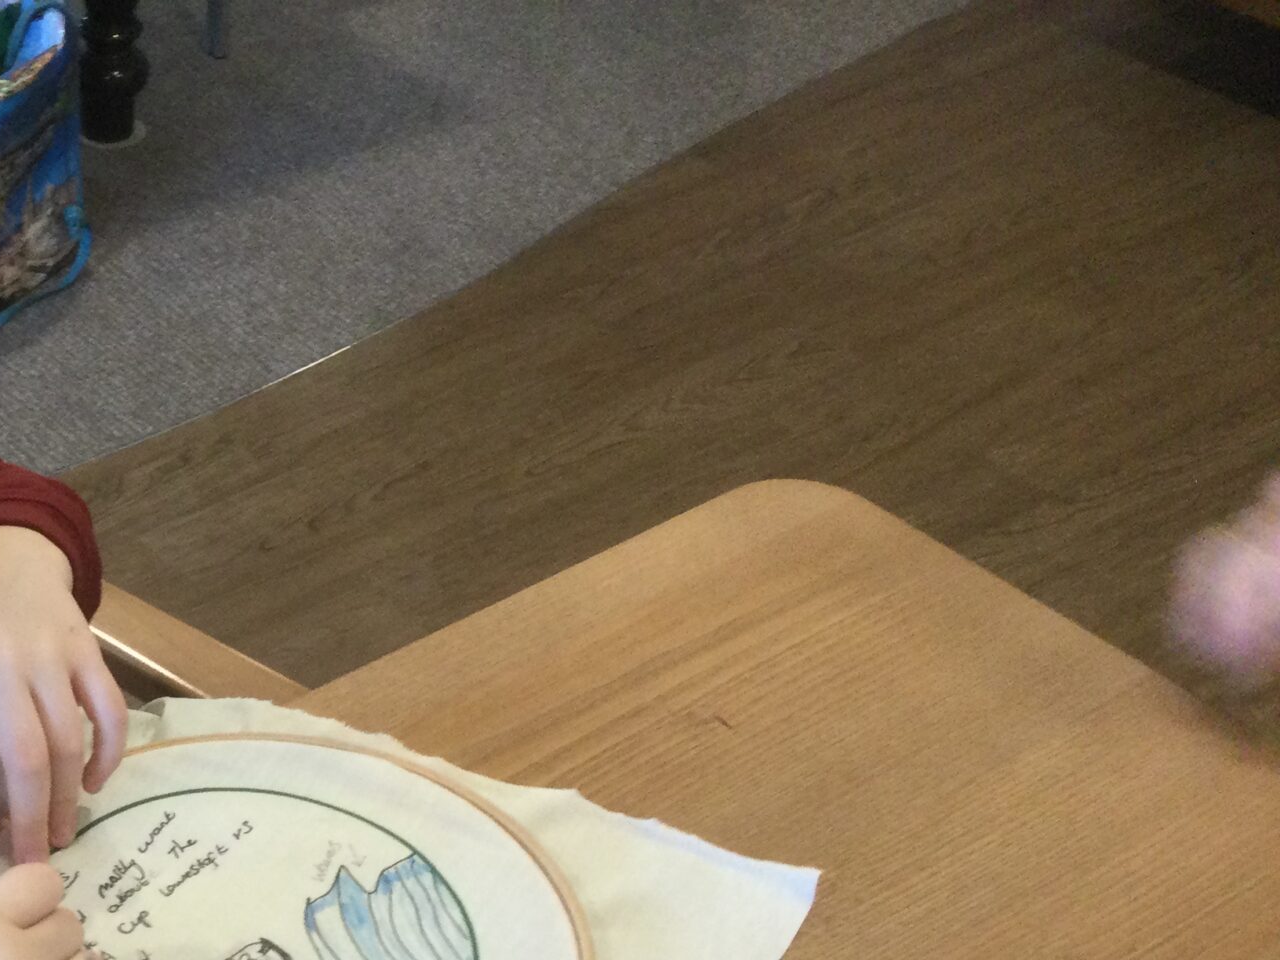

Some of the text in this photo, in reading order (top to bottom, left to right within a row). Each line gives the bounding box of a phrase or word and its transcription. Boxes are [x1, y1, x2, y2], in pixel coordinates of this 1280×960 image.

[138, 811, 176, 853] want
[167, 839, 198, 859] The
[117, 910, 152, 934] Cup
